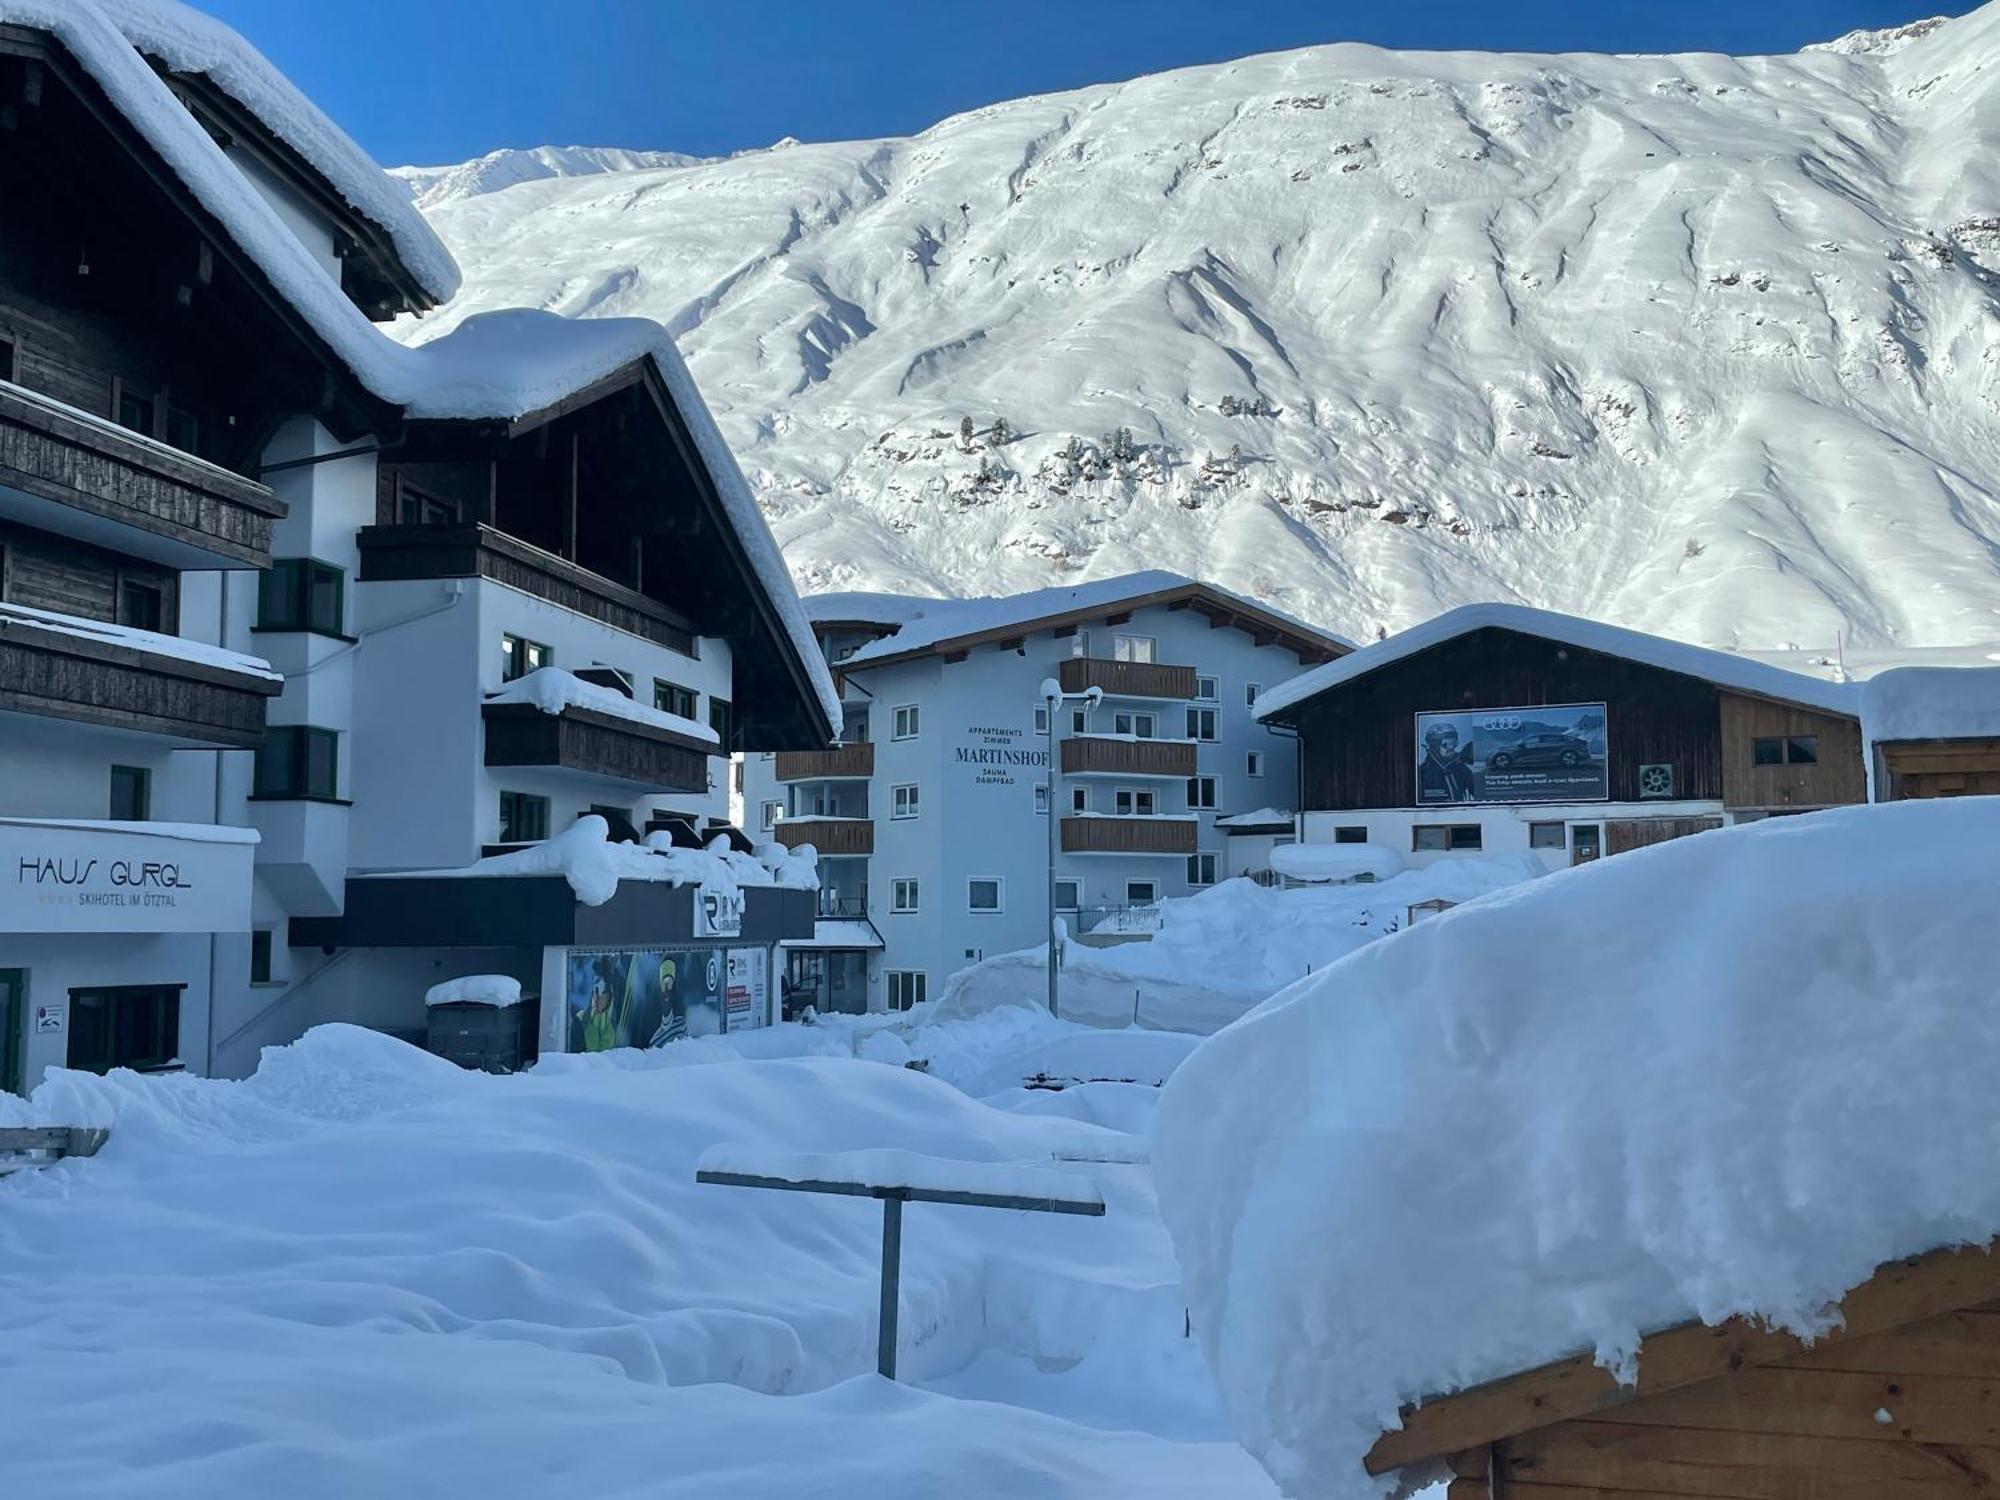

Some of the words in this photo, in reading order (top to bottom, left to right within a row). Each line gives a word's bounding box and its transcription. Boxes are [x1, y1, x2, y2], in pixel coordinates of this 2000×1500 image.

[968, 728, 1024, 737] APPARTEMENTS
[983, 737, 1011, 745] ZIMMER
[956, 747, 1049, 766] MARTINSHOF
[982, 768, 1007, 776] SAUNA
[975, 776, 1015, 785] DAMPFBAD
[19, 856, 97, 884] HAUS
[110, 861, 192, 888] GURGL
[79, 893, 126, 906] SKIHOTEL
[129, 894, 141, 906] IM
[144, 892, 176, 907] ÖTZTAL
